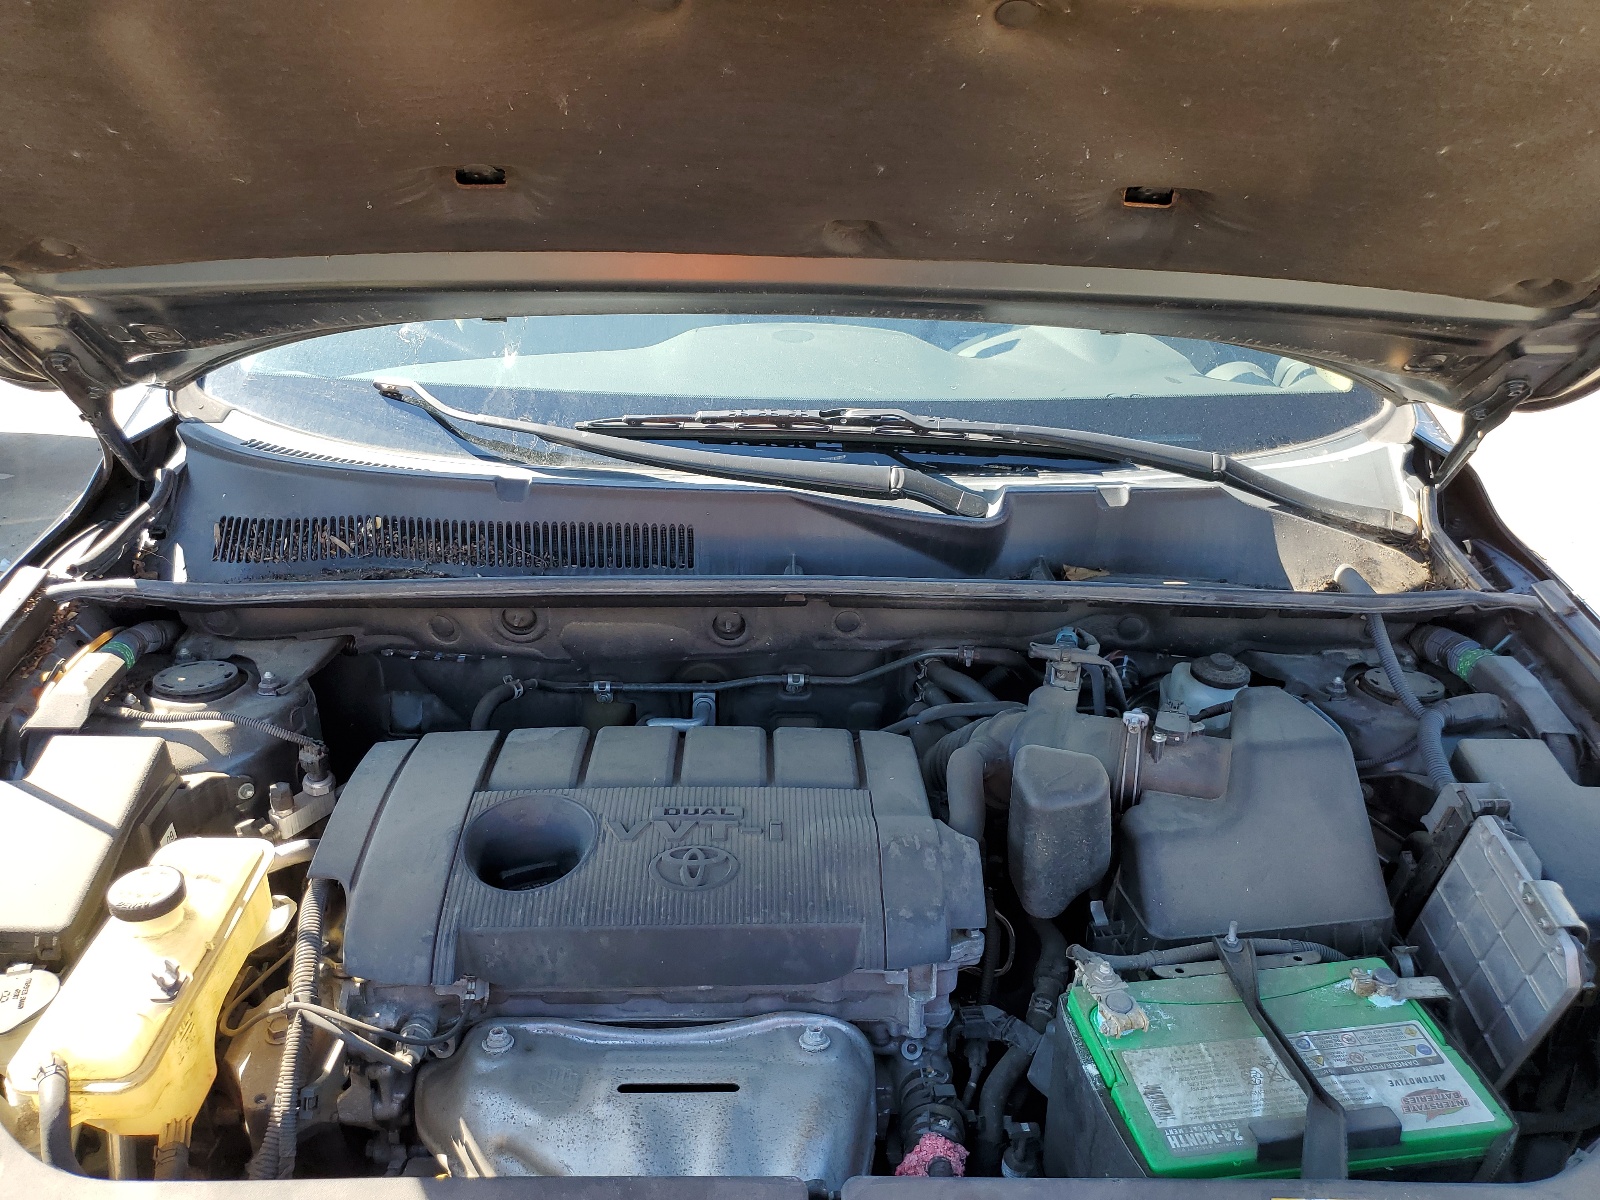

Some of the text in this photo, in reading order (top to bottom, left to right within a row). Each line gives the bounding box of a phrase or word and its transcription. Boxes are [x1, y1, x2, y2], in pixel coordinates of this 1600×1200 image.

[663, 807, 735, 816] DUAL
[606, 819, 784, 842] VVT-i
[1353, 1059, 1420, 1073] DANGER/POISON
[1388, 1073, 1446, 1087] AUTOMOTIVE
[1402, 1091, 1461, 1105] BATTERIES
[1403, 1099, 1469, 1114] INTERSTATE
[1166, 1127, 1244, 1149] 24-MONTH
